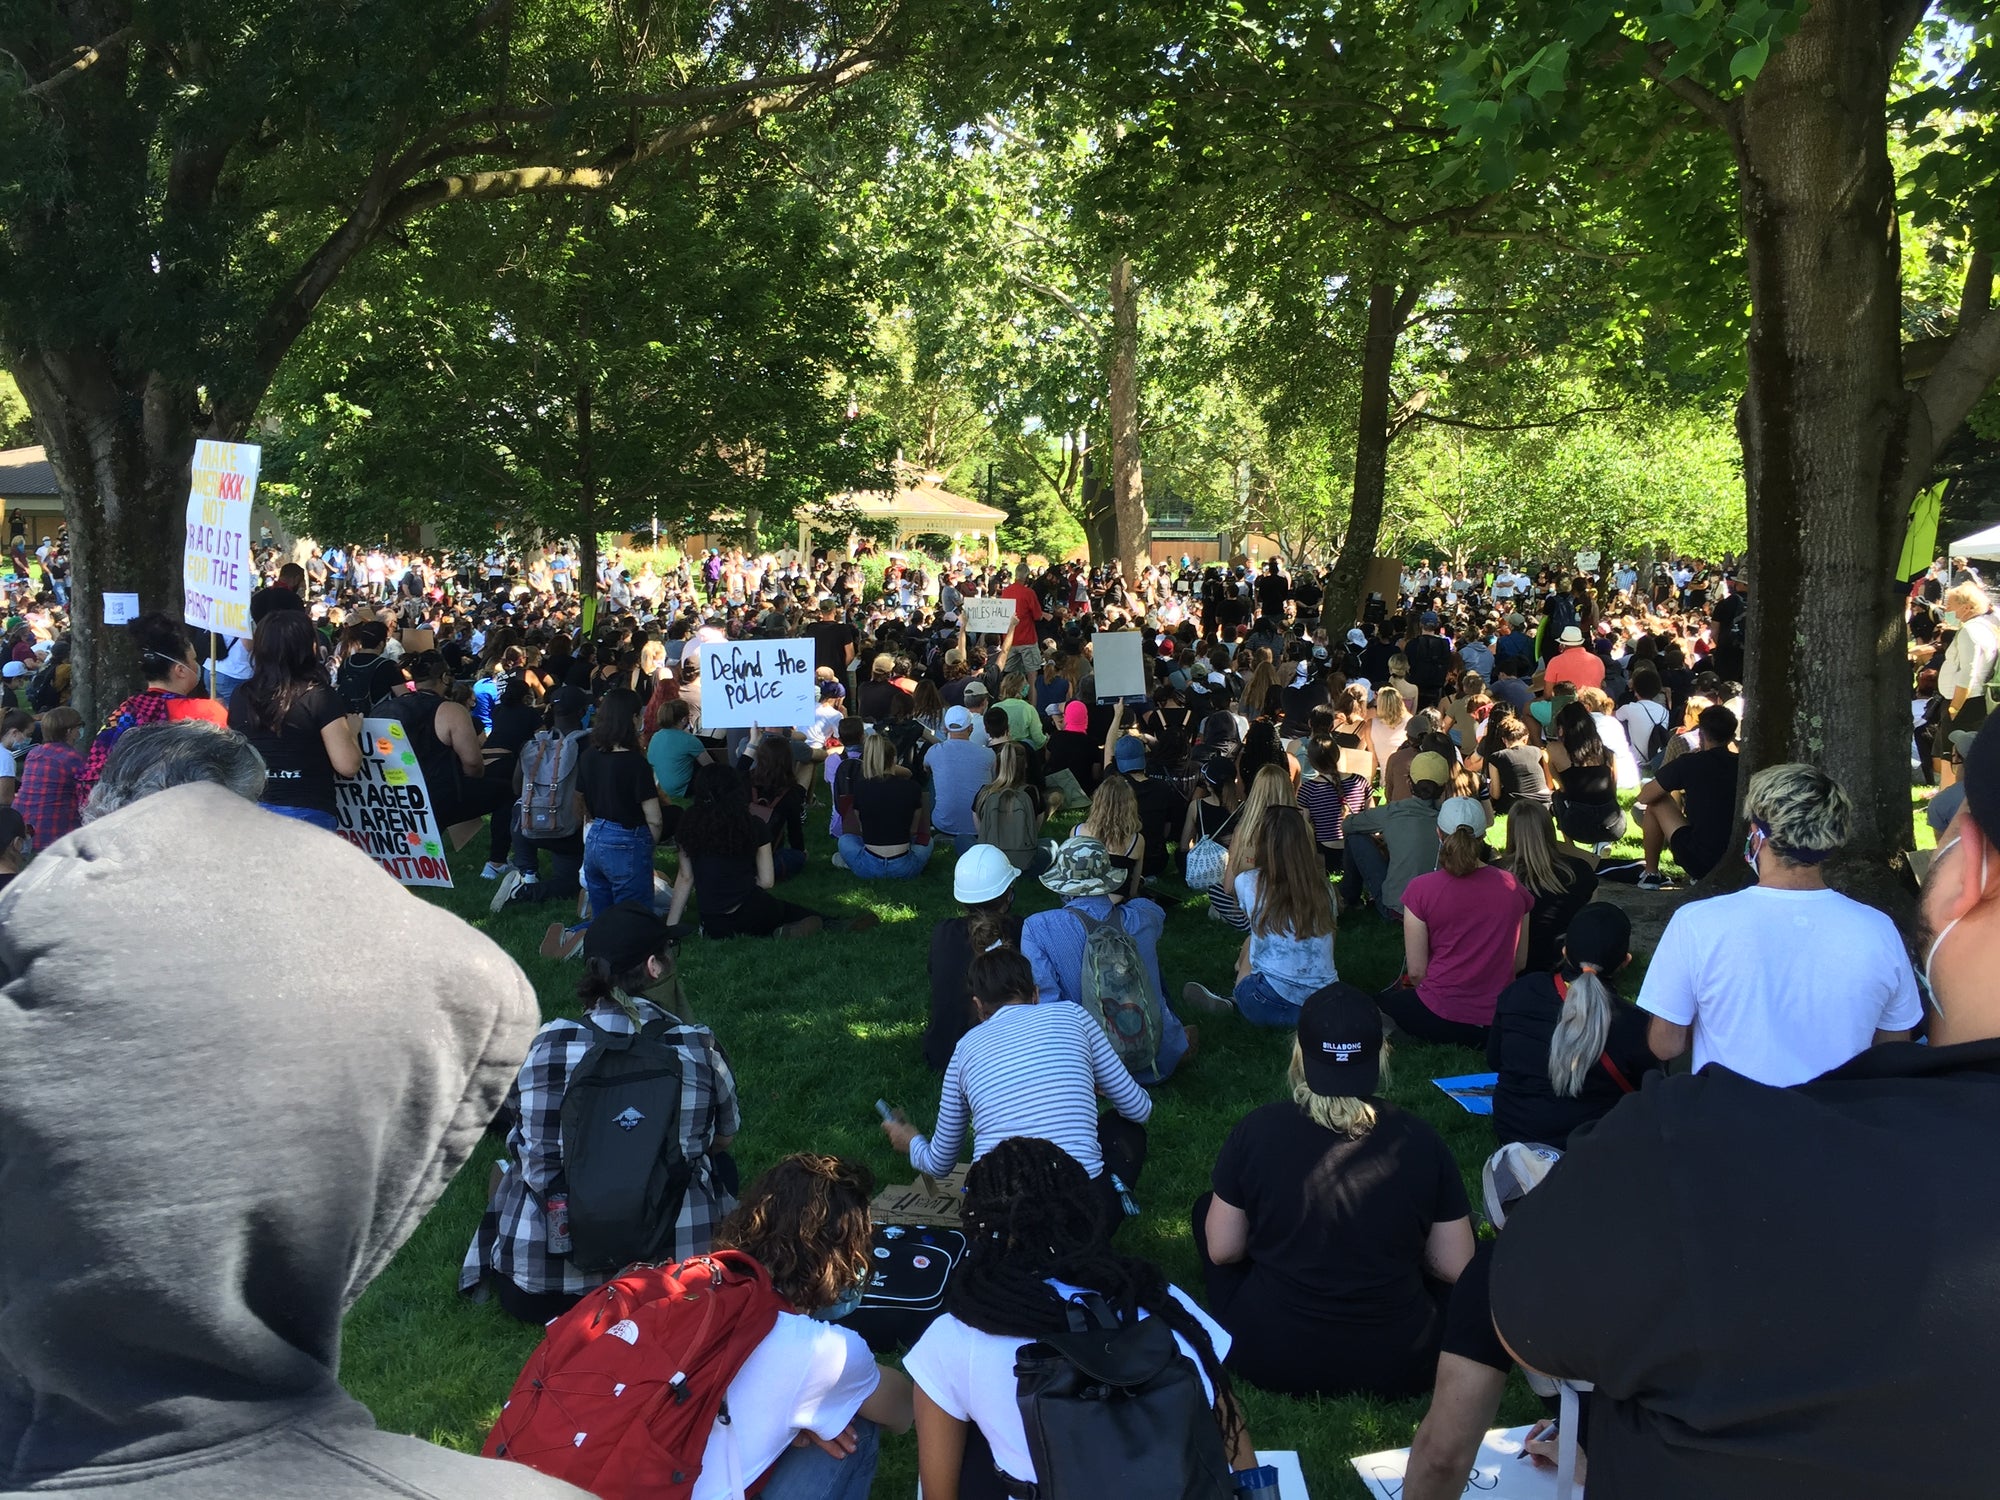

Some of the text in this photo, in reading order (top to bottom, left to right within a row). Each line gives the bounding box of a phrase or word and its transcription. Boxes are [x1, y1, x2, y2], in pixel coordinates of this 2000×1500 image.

[201, 442, 237, 471] MAKE
[202, 498, 227, 528] NOT
[187, 523, 242, 560] RACIST
[187, 555, 239, 591] FOR THE
[185, 589, 248, 633] FIRST TIME
[967, 606, 1010, 619] MILES HALL
[711, 646, 808, 683] Defund the
[724, 680, 783, 710] POLICE
[359, 807, 429, 834] ARENT
[1322, 1041, 1362, 1050] BILLABONG
